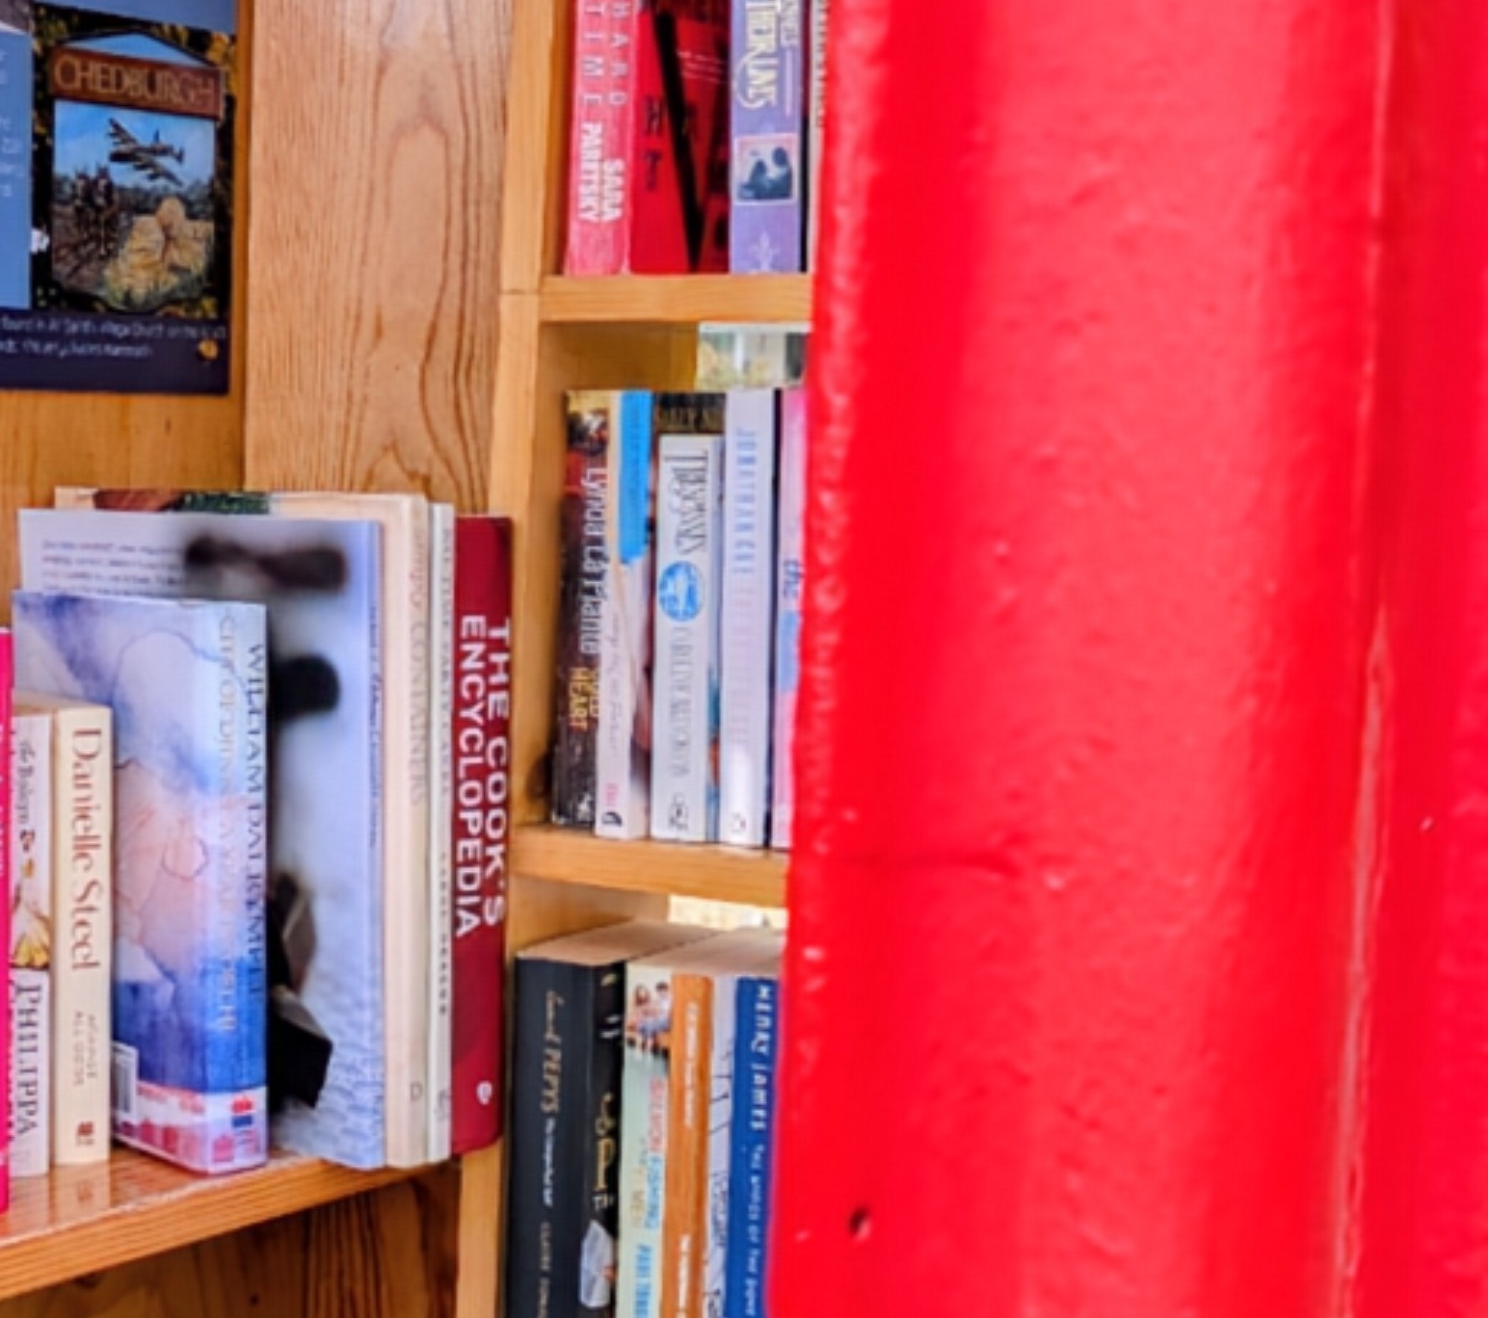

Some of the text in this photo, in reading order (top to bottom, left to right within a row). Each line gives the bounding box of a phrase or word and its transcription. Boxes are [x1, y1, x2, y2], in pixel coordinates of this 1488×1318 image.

[56, 53, 214, 112] CHEDBURGH
[577, 121, 601, 223] PARETSKY
[601, 158, 624, 221] SARA
[579, 467, 606, 536] Lynda
[217, 613, 235, 674] CITY
[567, 667, 589, 732] HEART
[407, 619, 427, 806] CONTAINERS
[482, 618, 510, 927] THE COOK'S
[243, 642, 264, 1001] WILLIAM DALRYMPLE
[453, 614, 484, 937] ENCYCLOPEDIA
[69, 726, 101, 971] Danielle Steel
[14, 983, 40, 1136] PHILIPPA
[540, 1046, 561, 1114] PEPYS
[748, 985, 771, 1132] HENRY JAMES
